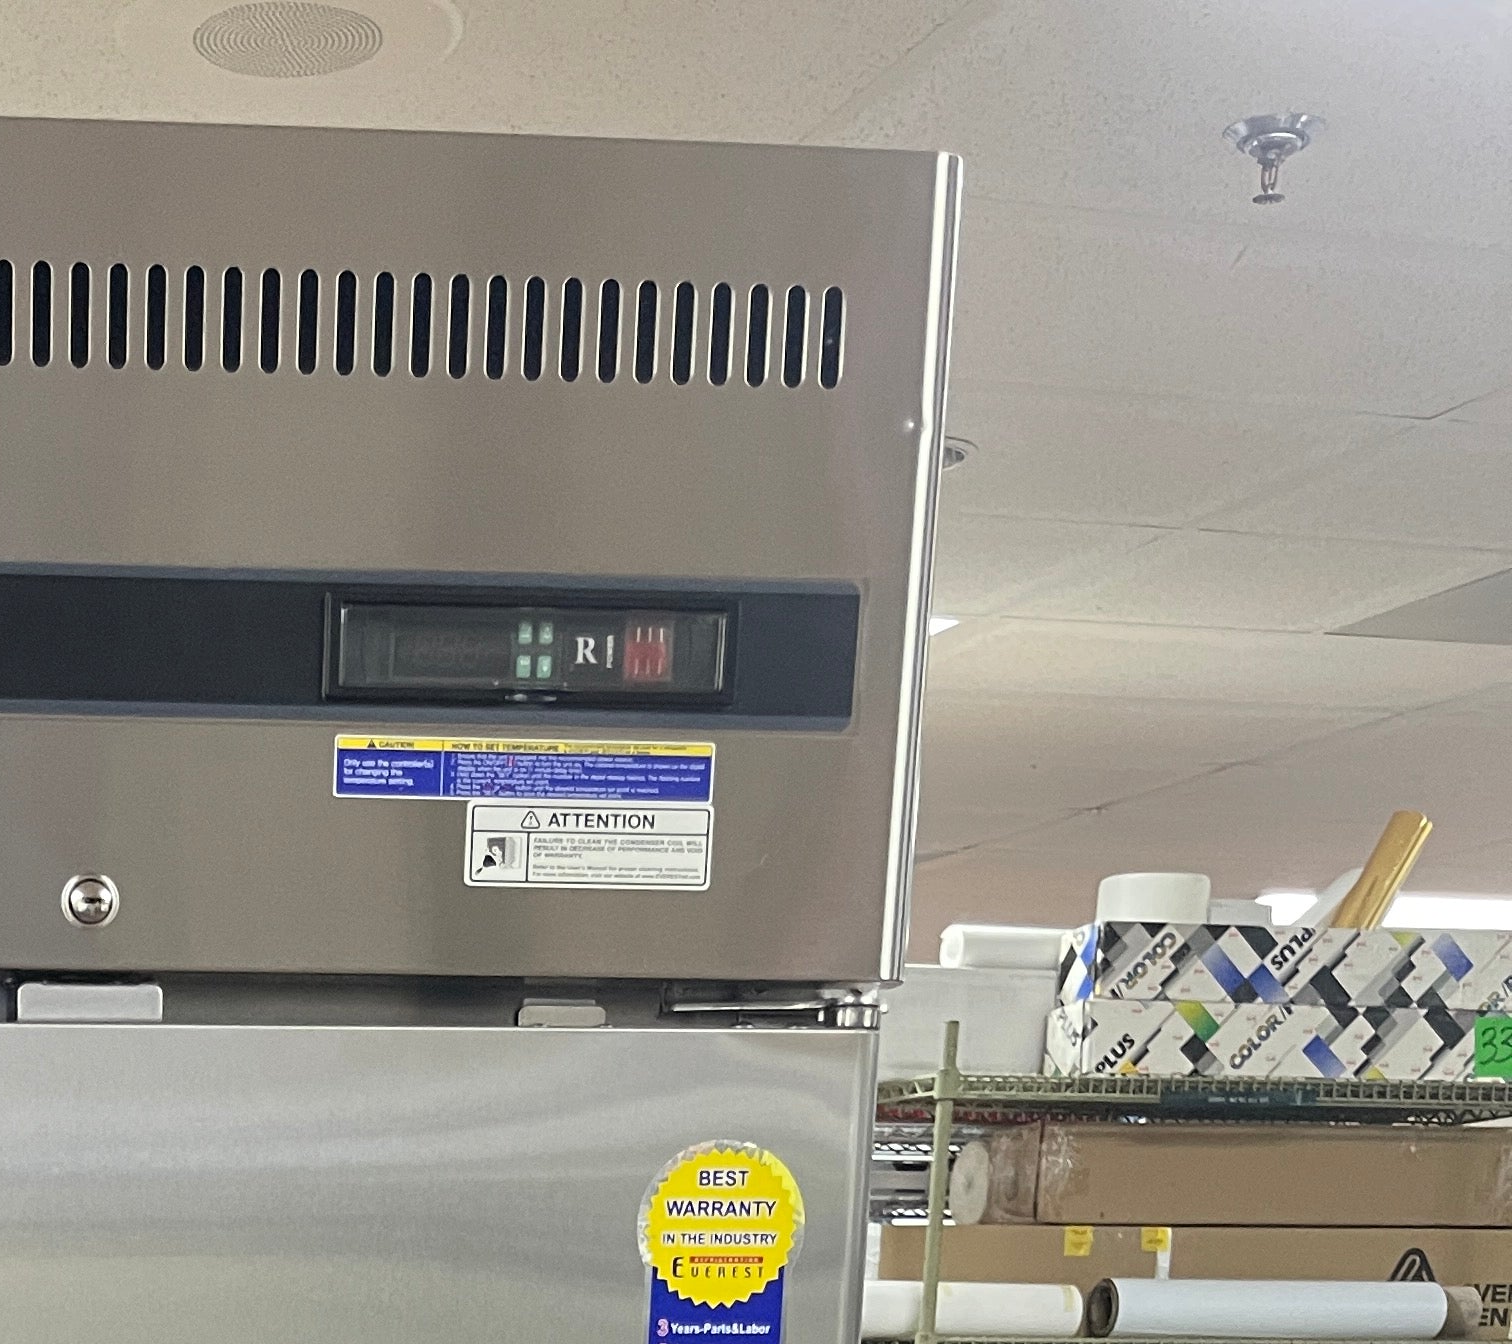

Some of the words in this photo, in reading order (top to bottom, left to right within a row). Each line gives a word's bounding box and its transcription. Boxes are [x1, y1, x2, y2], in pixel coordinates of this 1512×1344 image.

[575, 636, 598, 665] R
[379, 741, 414, 749] CAUTION
[451, 742, 470, 751] HOW
[473, 743, 483, 751] TO
[502, 743, 559, 752] TEMPERATURE
[343, 759, 360, 768] Only
[378, 759, 389, 767] the
[355, 769, 389, 778] changing
[548, 813, 655, 830] ATTENTION
[533, 837, 564, 845] FAILURE
[533, 844, 560, 852] RESULT
[1095, 1033, 1135, 1074] PLUS
[699, 1170, 749, 1187] BEST
[666, 1200, 777, 1217] WARRANTY
[662, 1233, 675, 1245] IN
[681, 1233, 706, 1245] THE
[710, 1233, 777, 1245] INDUSTRY
[672, 1256, 764, 1279] EVEREST
[657, 1318, 669, 1337] 3
[670, 1323, 771, 1335] Years-Parts&Labor
